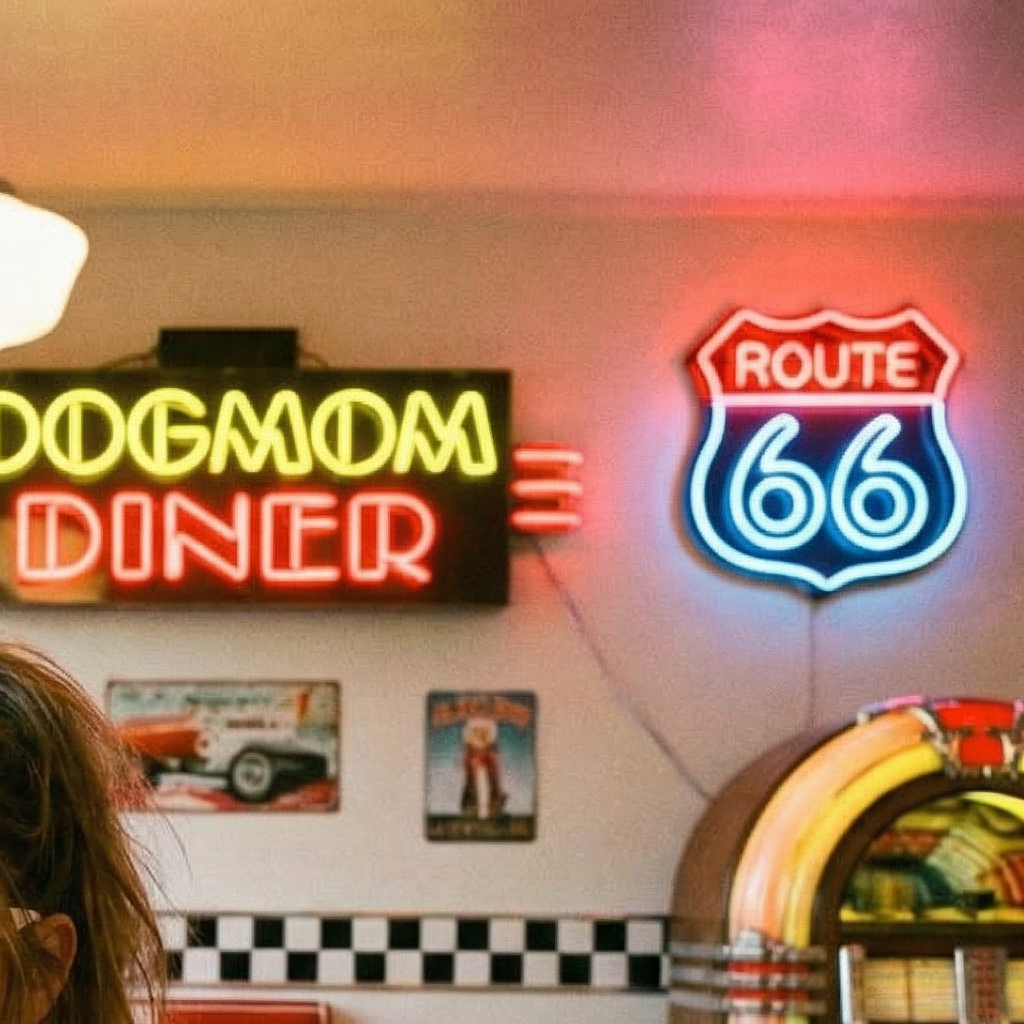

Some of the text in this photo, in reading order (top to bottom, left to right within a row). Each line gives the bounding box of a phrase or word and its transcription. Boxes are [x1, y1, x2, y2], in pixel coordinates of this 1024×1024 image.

[734, 340, 920, 389] ROUTE
[729, 413, 929, 551] 66
[15, 492, 437, 585] DINER
